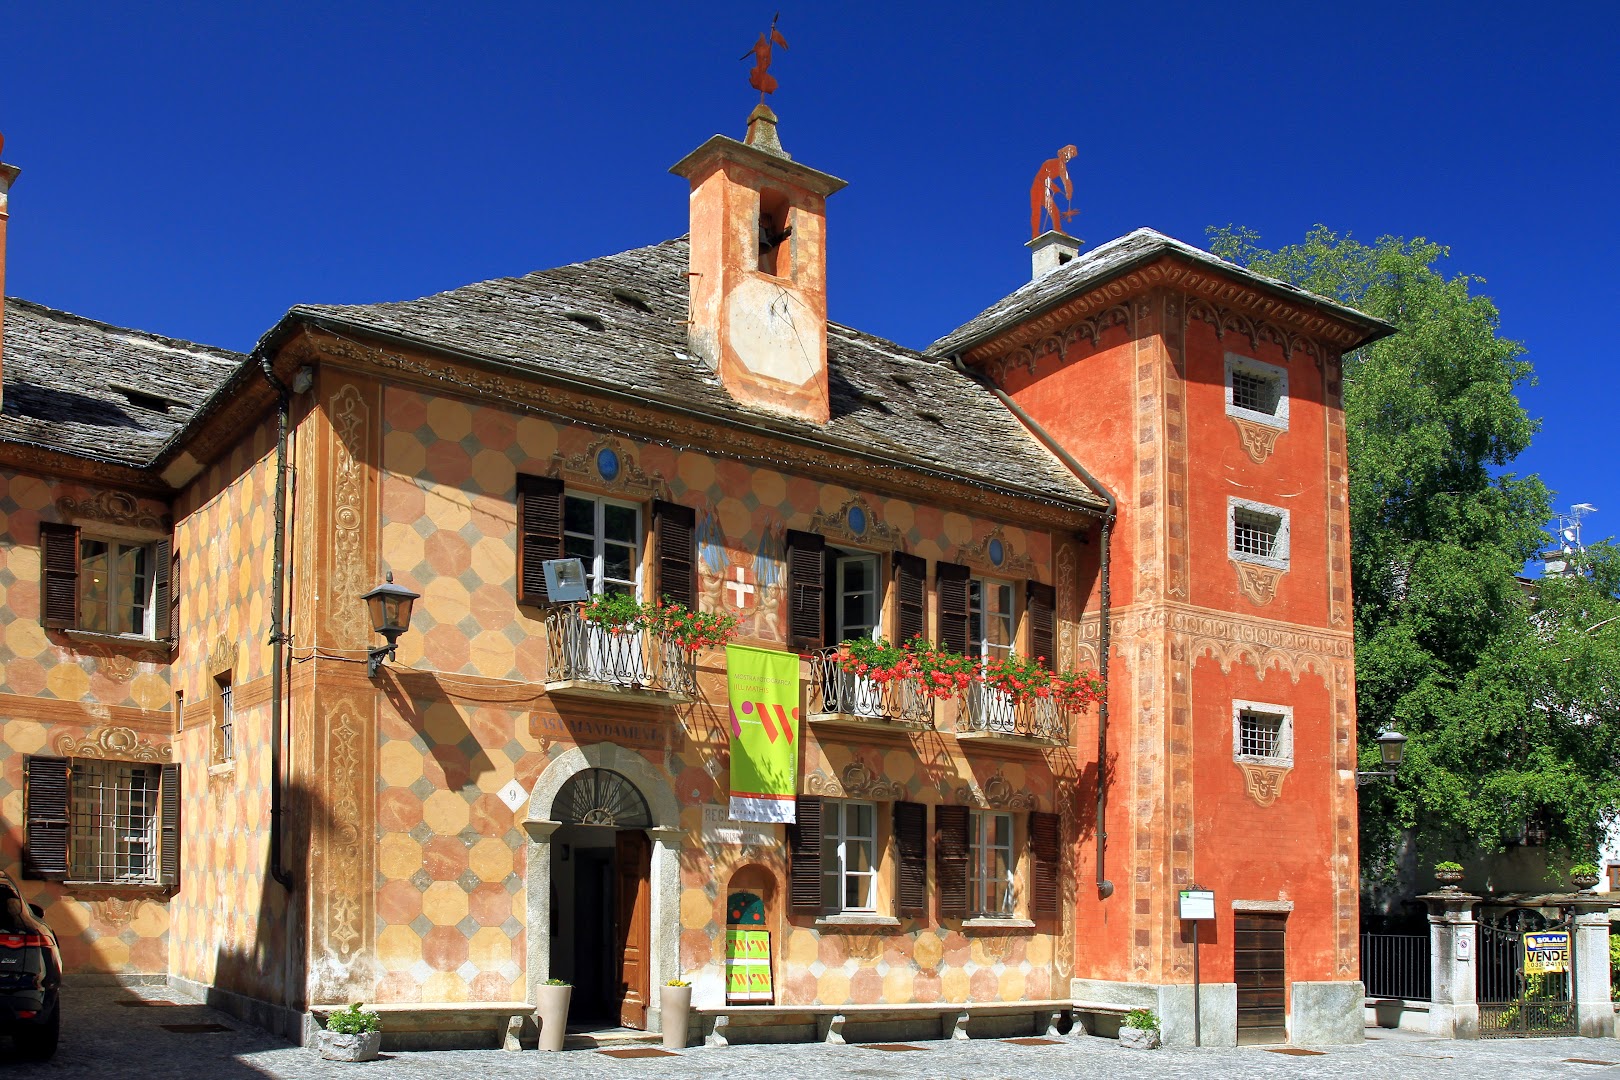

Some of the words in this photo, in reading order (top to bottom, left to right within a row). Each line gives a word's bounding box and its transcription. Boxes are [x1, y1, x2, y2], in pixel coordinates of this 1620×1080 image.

[734, 673, 756, 682] MOSTRA
[745, 685, 769, 694] MATHIS
[509, 789, 517, 802] 9
[1527, 951, 1568, 962] VENDE
